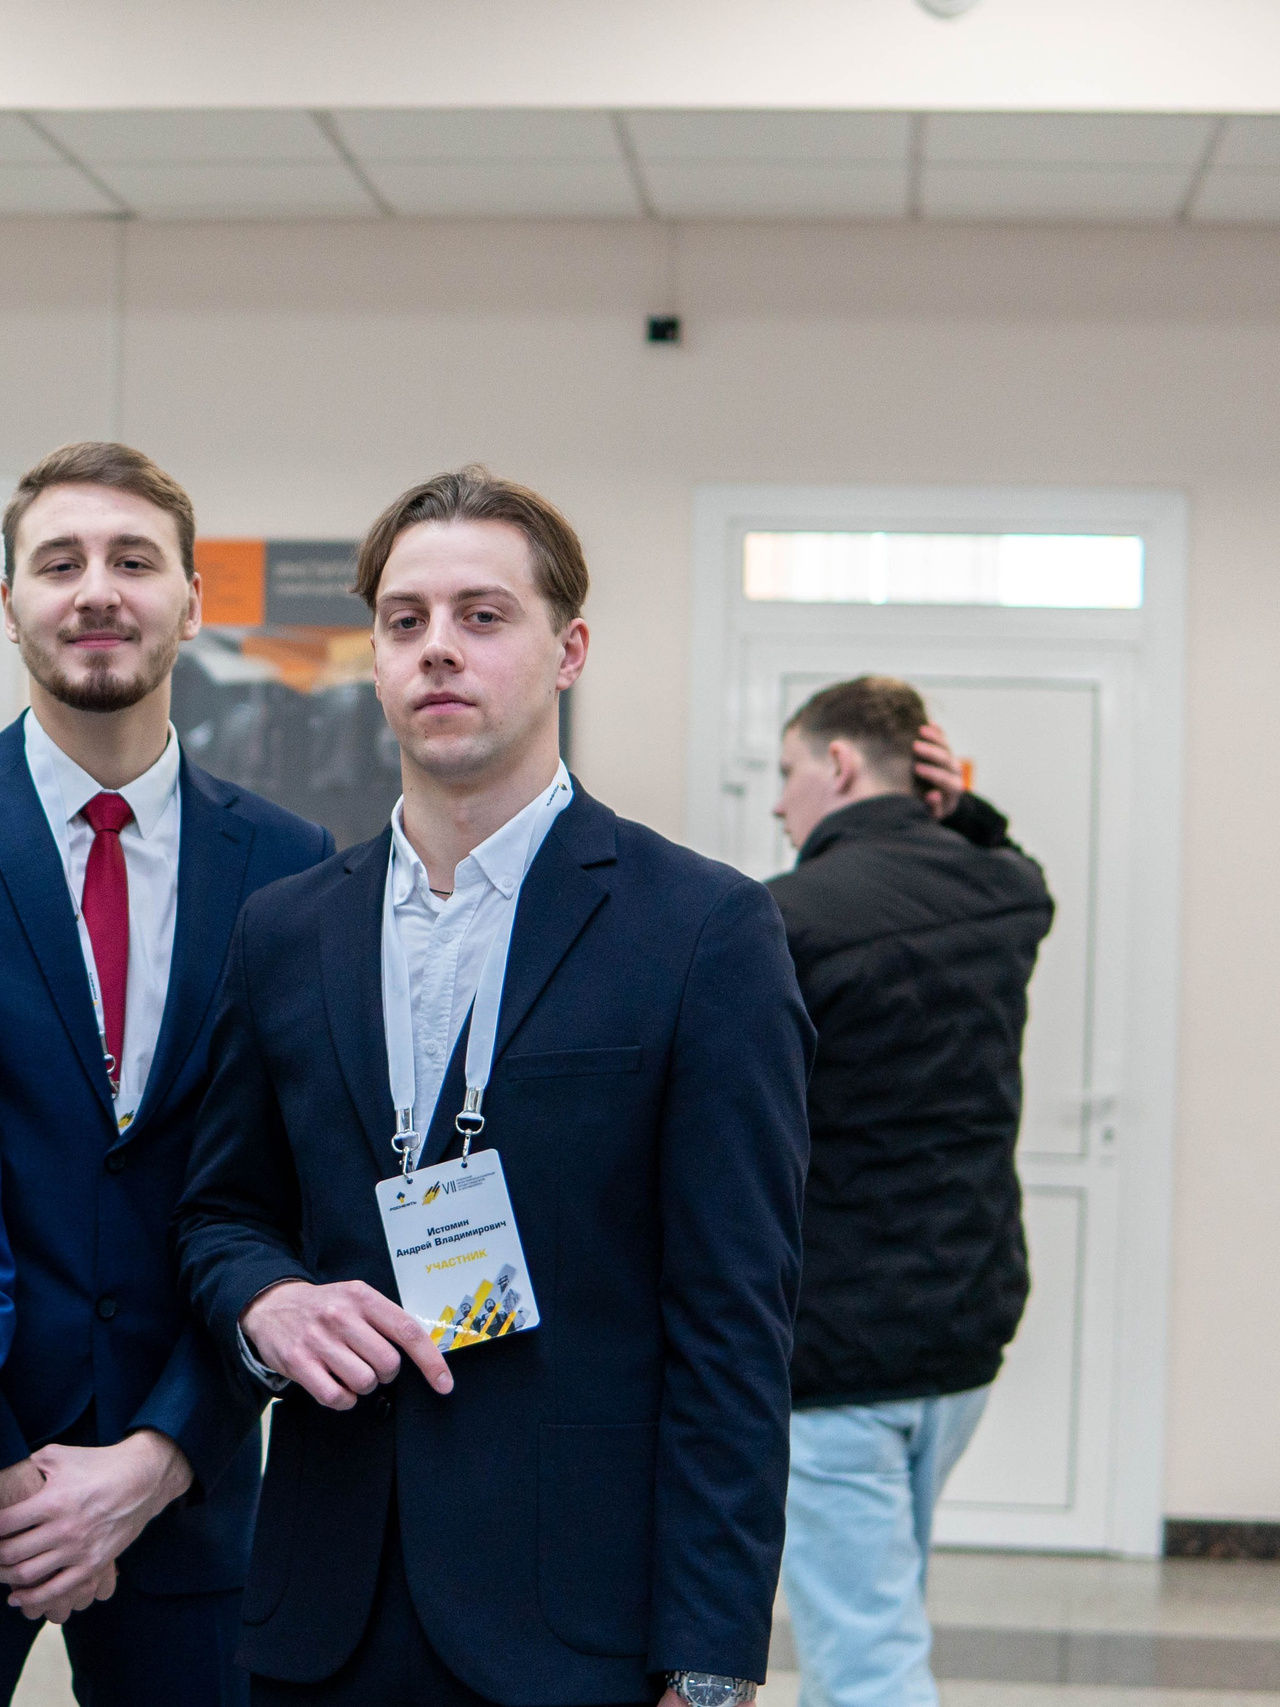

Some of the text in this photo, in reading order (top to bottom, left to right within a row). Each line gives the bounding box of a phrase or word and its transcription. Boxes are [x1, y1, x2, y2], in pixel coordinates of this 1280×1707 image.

[441, 1179, 457, 1195] VII
[396, 1220, 507, 1258] Андрей Владимирович
[426, 1219, 470, 1237] Истомин
[424, 1248, 488, 1274] УЧАСТНИК
